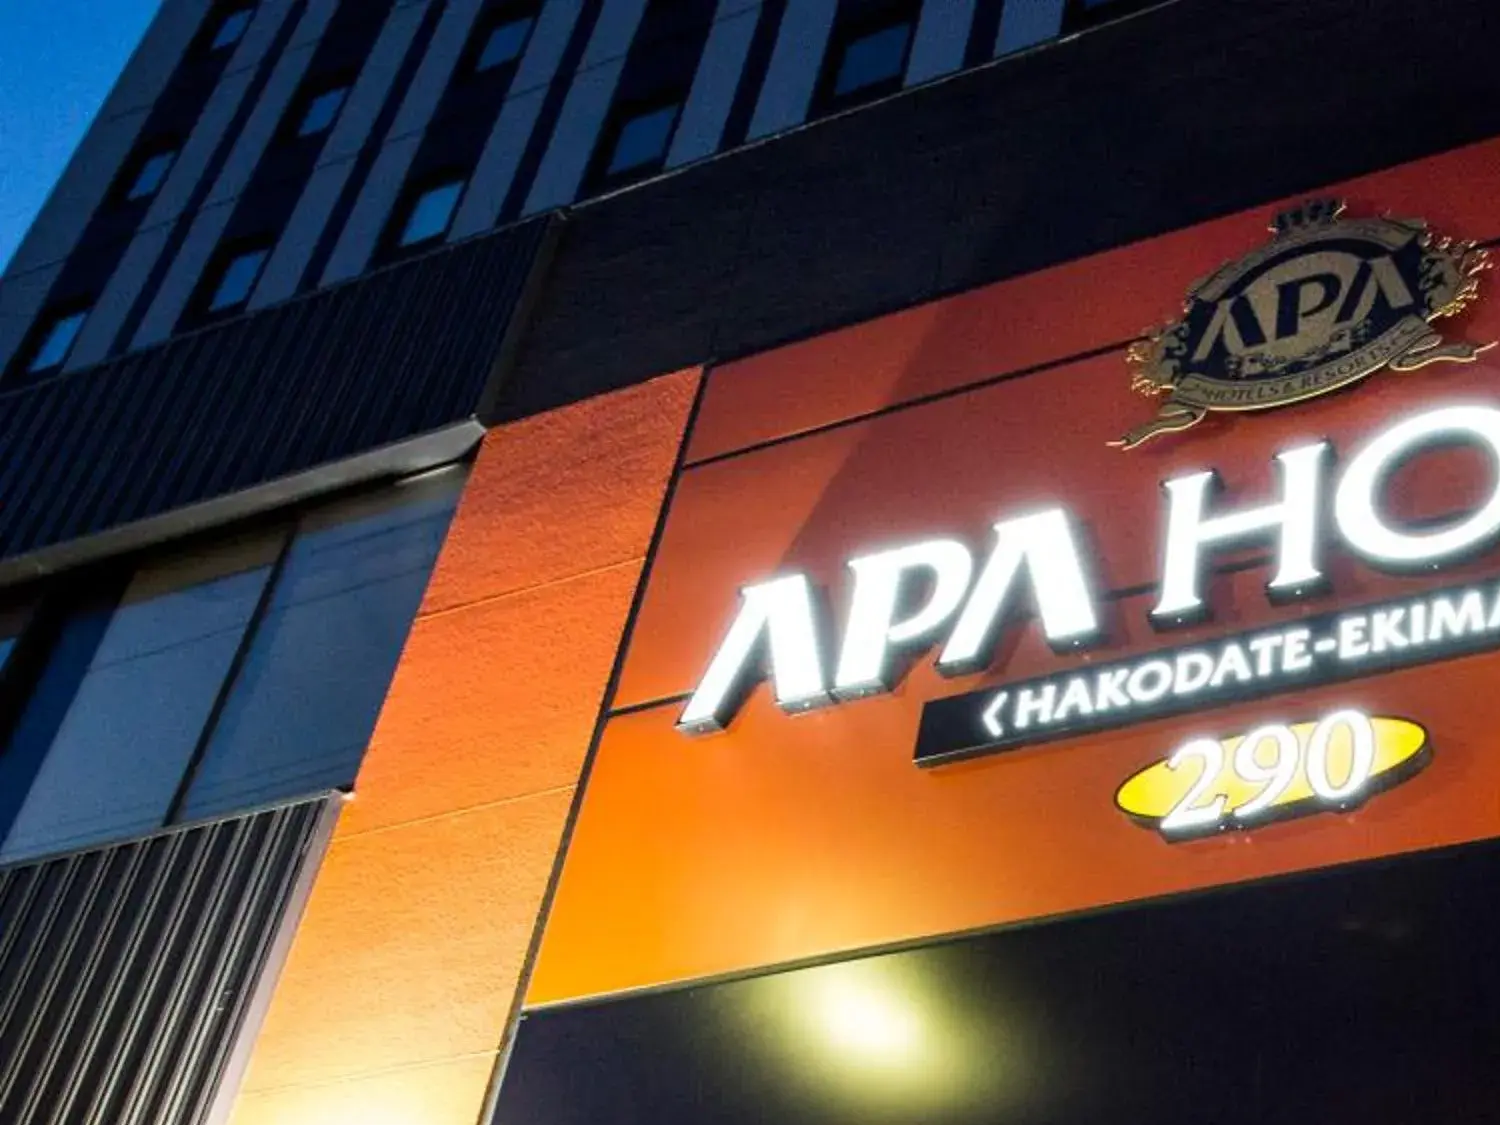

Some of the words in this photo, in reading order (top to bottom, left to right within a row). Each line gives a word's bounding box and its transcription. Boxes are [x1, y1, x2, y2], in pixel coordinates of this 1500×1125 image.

[1191, 256, 1417, 363] APA
[677, 507, 1099, 730] APA
[1160, 708, 1375, 832] 290
